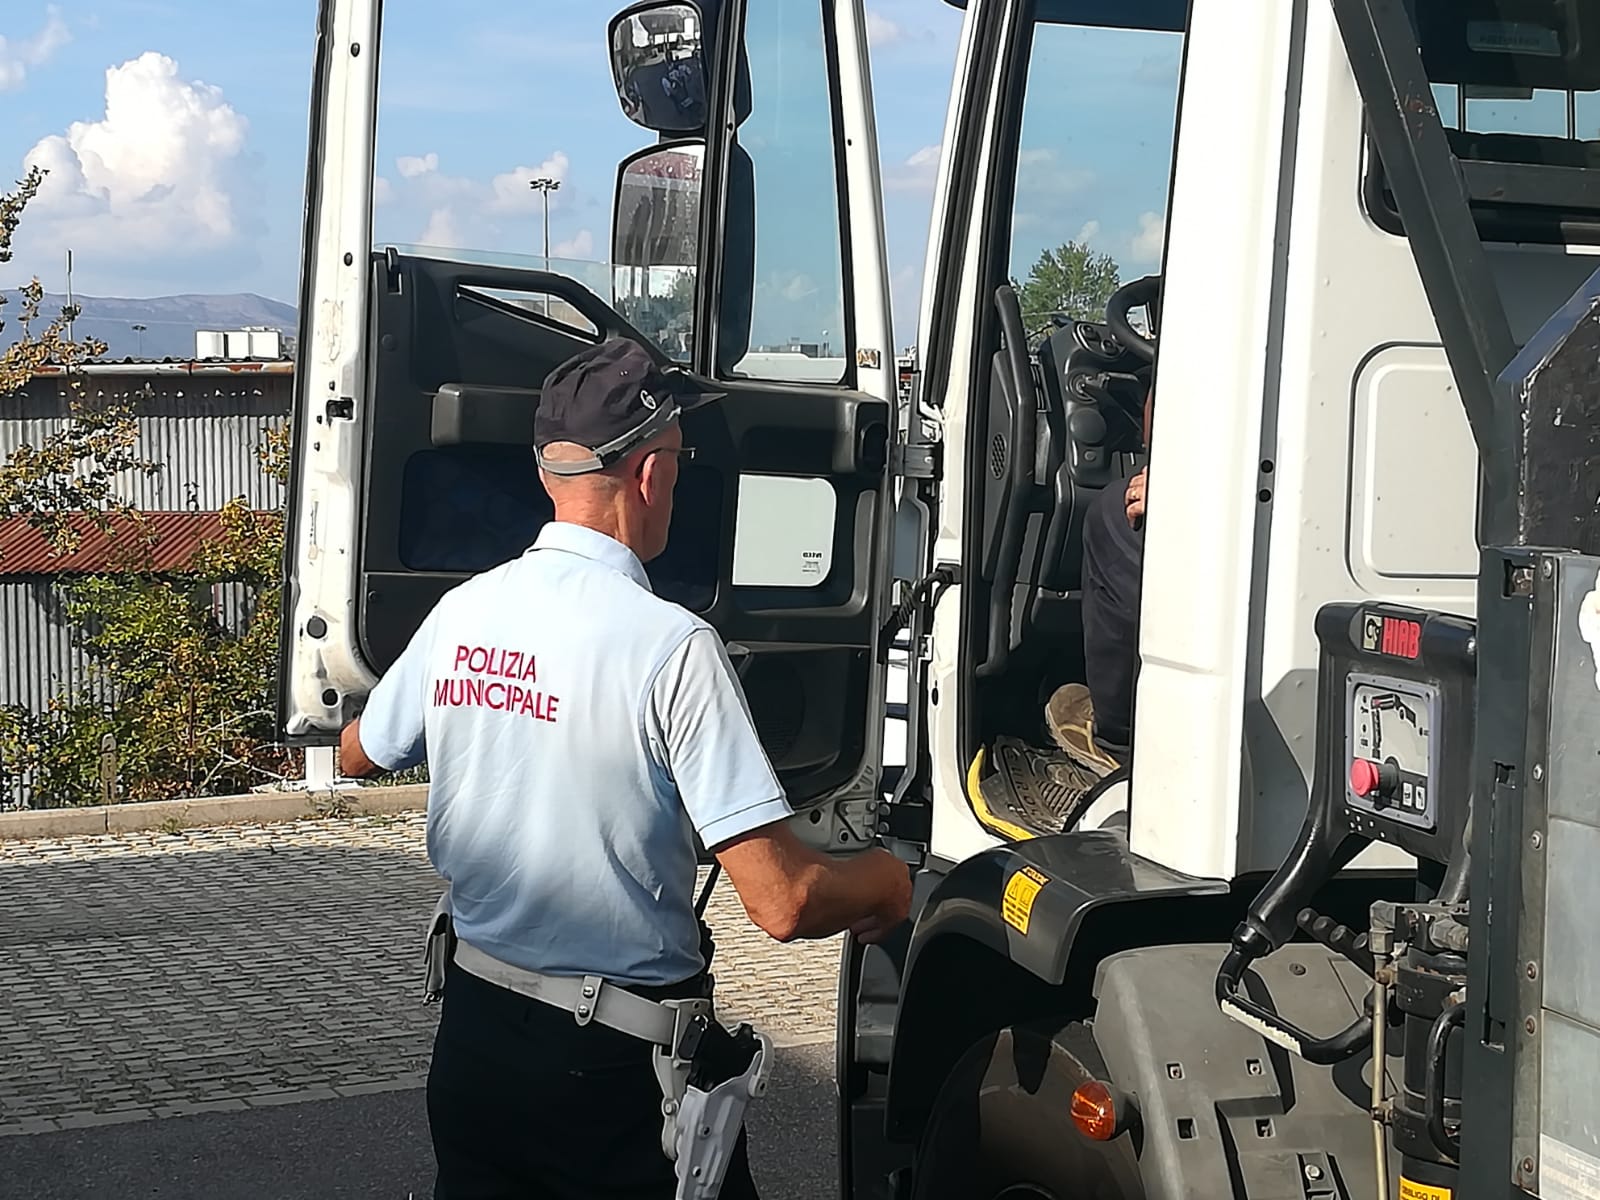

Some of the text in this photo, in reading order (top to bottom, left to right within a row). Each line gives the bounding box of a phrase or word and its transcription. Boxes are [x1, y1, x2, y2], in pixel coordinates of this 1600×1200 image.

[1382, 617, 1421, 659] HIAB
[454, 645, 537, 683] POLIZIA
[434, 678, 560, 723] MUNICIPALE
